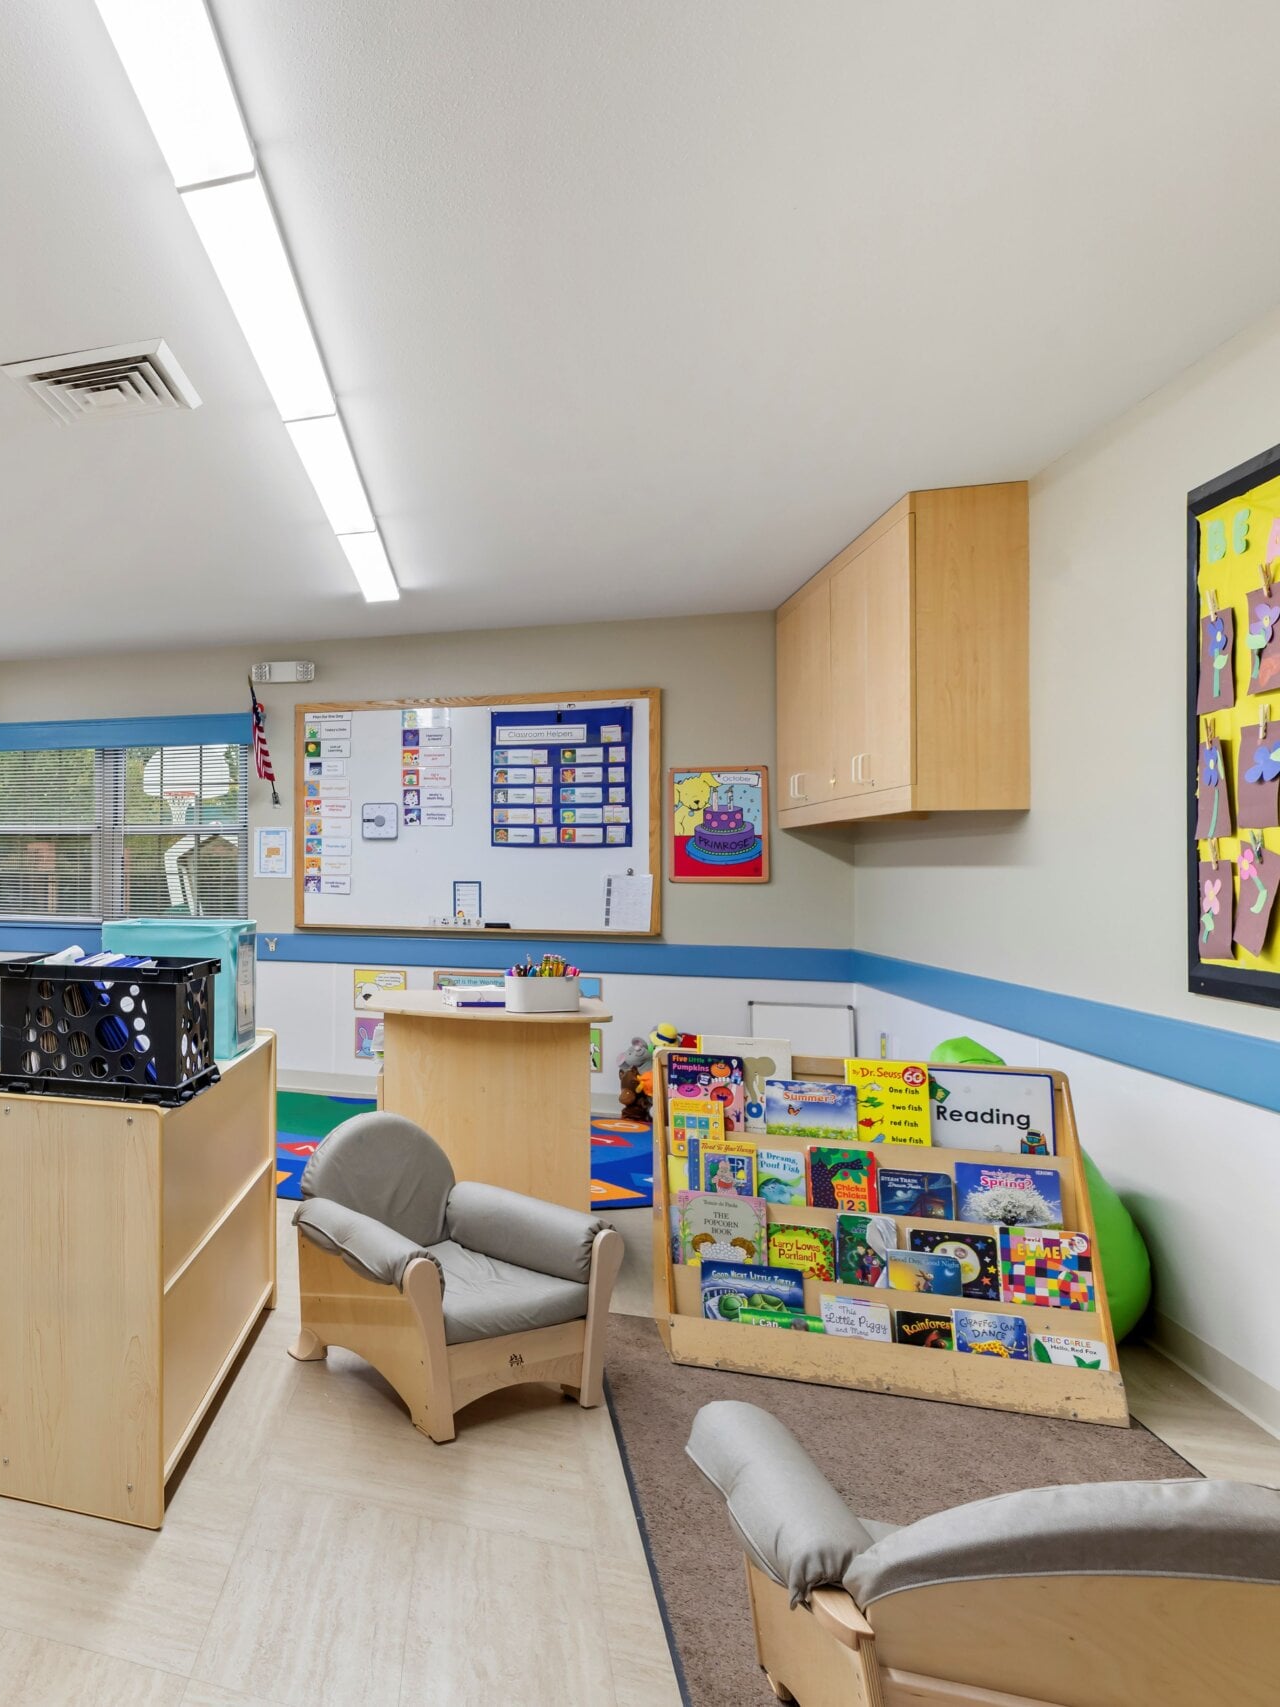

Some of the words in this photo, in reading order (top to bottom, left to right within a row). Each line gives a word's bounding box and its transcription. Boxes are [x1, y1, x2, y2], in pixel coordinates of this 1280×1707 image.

[1207, 508, 1250, 564] BE
[699, 837, 750, 850] PRIMROSE
[672, 1055, 688, 1063] Five
[672, 1063, 709, 1072] Pumpkins
[860, 1067, 876, 1078] Dr.
[877, 1069, 902, 1079] Seuss
[904, 1071, 923, 1083] 60
[888, 1086, 903, 1094] One
[905, 1088, 920, 1096] fish
[783, 1092, 837, 1104] Summer?
[907, 1104, 923, 1112] fish
[936, 1105, 1031, 1130] Reading
[890, 1119, 902, 1127] red
[903, 1120, 919, 1128] fish
[891, 1135, 906, 1144] blue
[907, 1136, 924, 1145] fish
[783, 1164, 800, 1174] Fish
[836, 1183, 866, 1193] Chicka
[980, 1176, 1033, 1190] Spring?
[836, 1191, 867, 1200] Chicka
[846, 1200, 856, 1212] 2
[858, 1201, 867, 1213] 3
[713, 1211, 729, 1219] THE
[704, 1218, 738, 1228] POPCORN
[711, 1227, 732, 1235] BOOK
[772, 1238, 794, 1251] Larry
[795, 1240, 820, 1252] Loves
[778, 1249, 817, 1262] Portland!
[1017, 1243, 1072, 1260] ELMER
[839, 1305, 857, 1315] This
[825, 1313, 855, 1326] Little
[858, 1316, 888, 1335] Piggy
[960, 1317, 998, 1329] GIRAFFES
[971, 1330, 1007, 1341] DANCE
[1042, 1336, 1061, 1344] ERIC
[1063, 1339, 1091, 1348] CARLE
